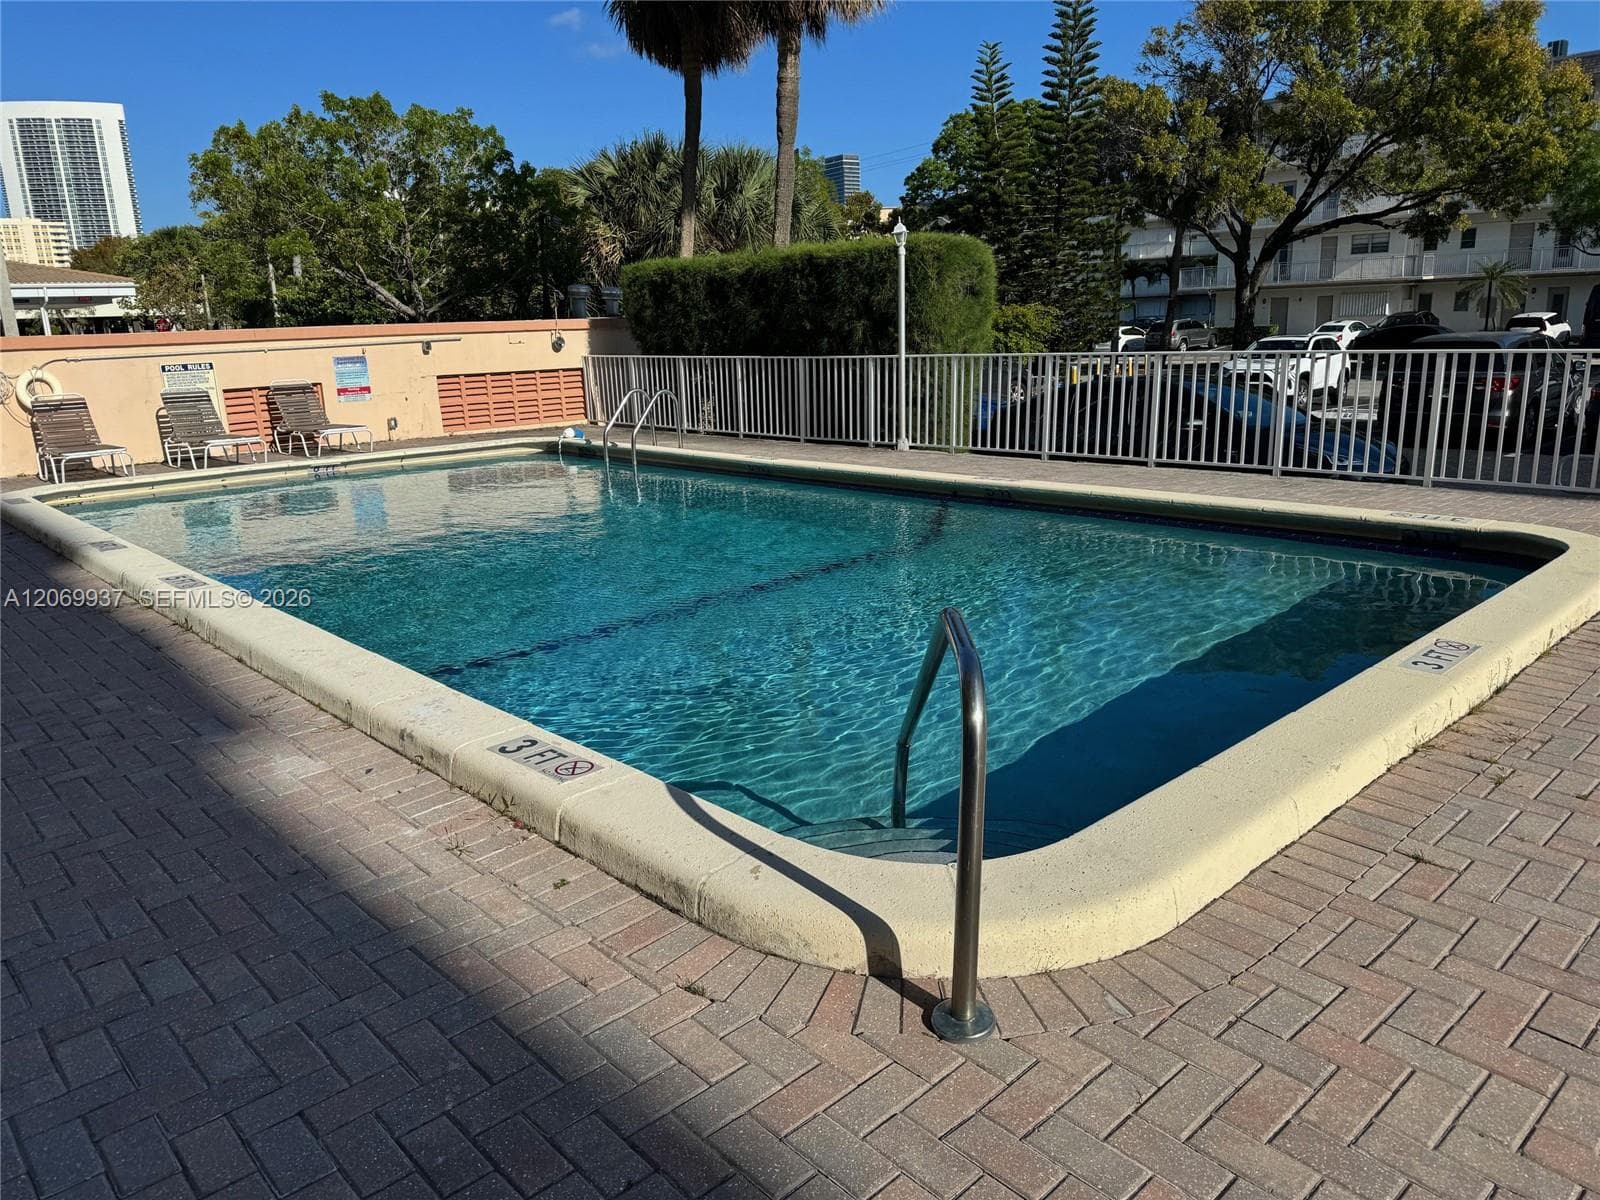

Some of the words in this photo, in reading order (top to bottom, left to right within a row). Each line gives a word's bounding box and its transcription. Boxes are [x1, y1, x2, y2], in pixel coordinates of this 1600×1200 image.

[1422, 649, 1460, 662] FT
[1411, 660, 1444, 670] 3
[498, 739, 538, 754] 3
[524, 749, 568, 765] FT
